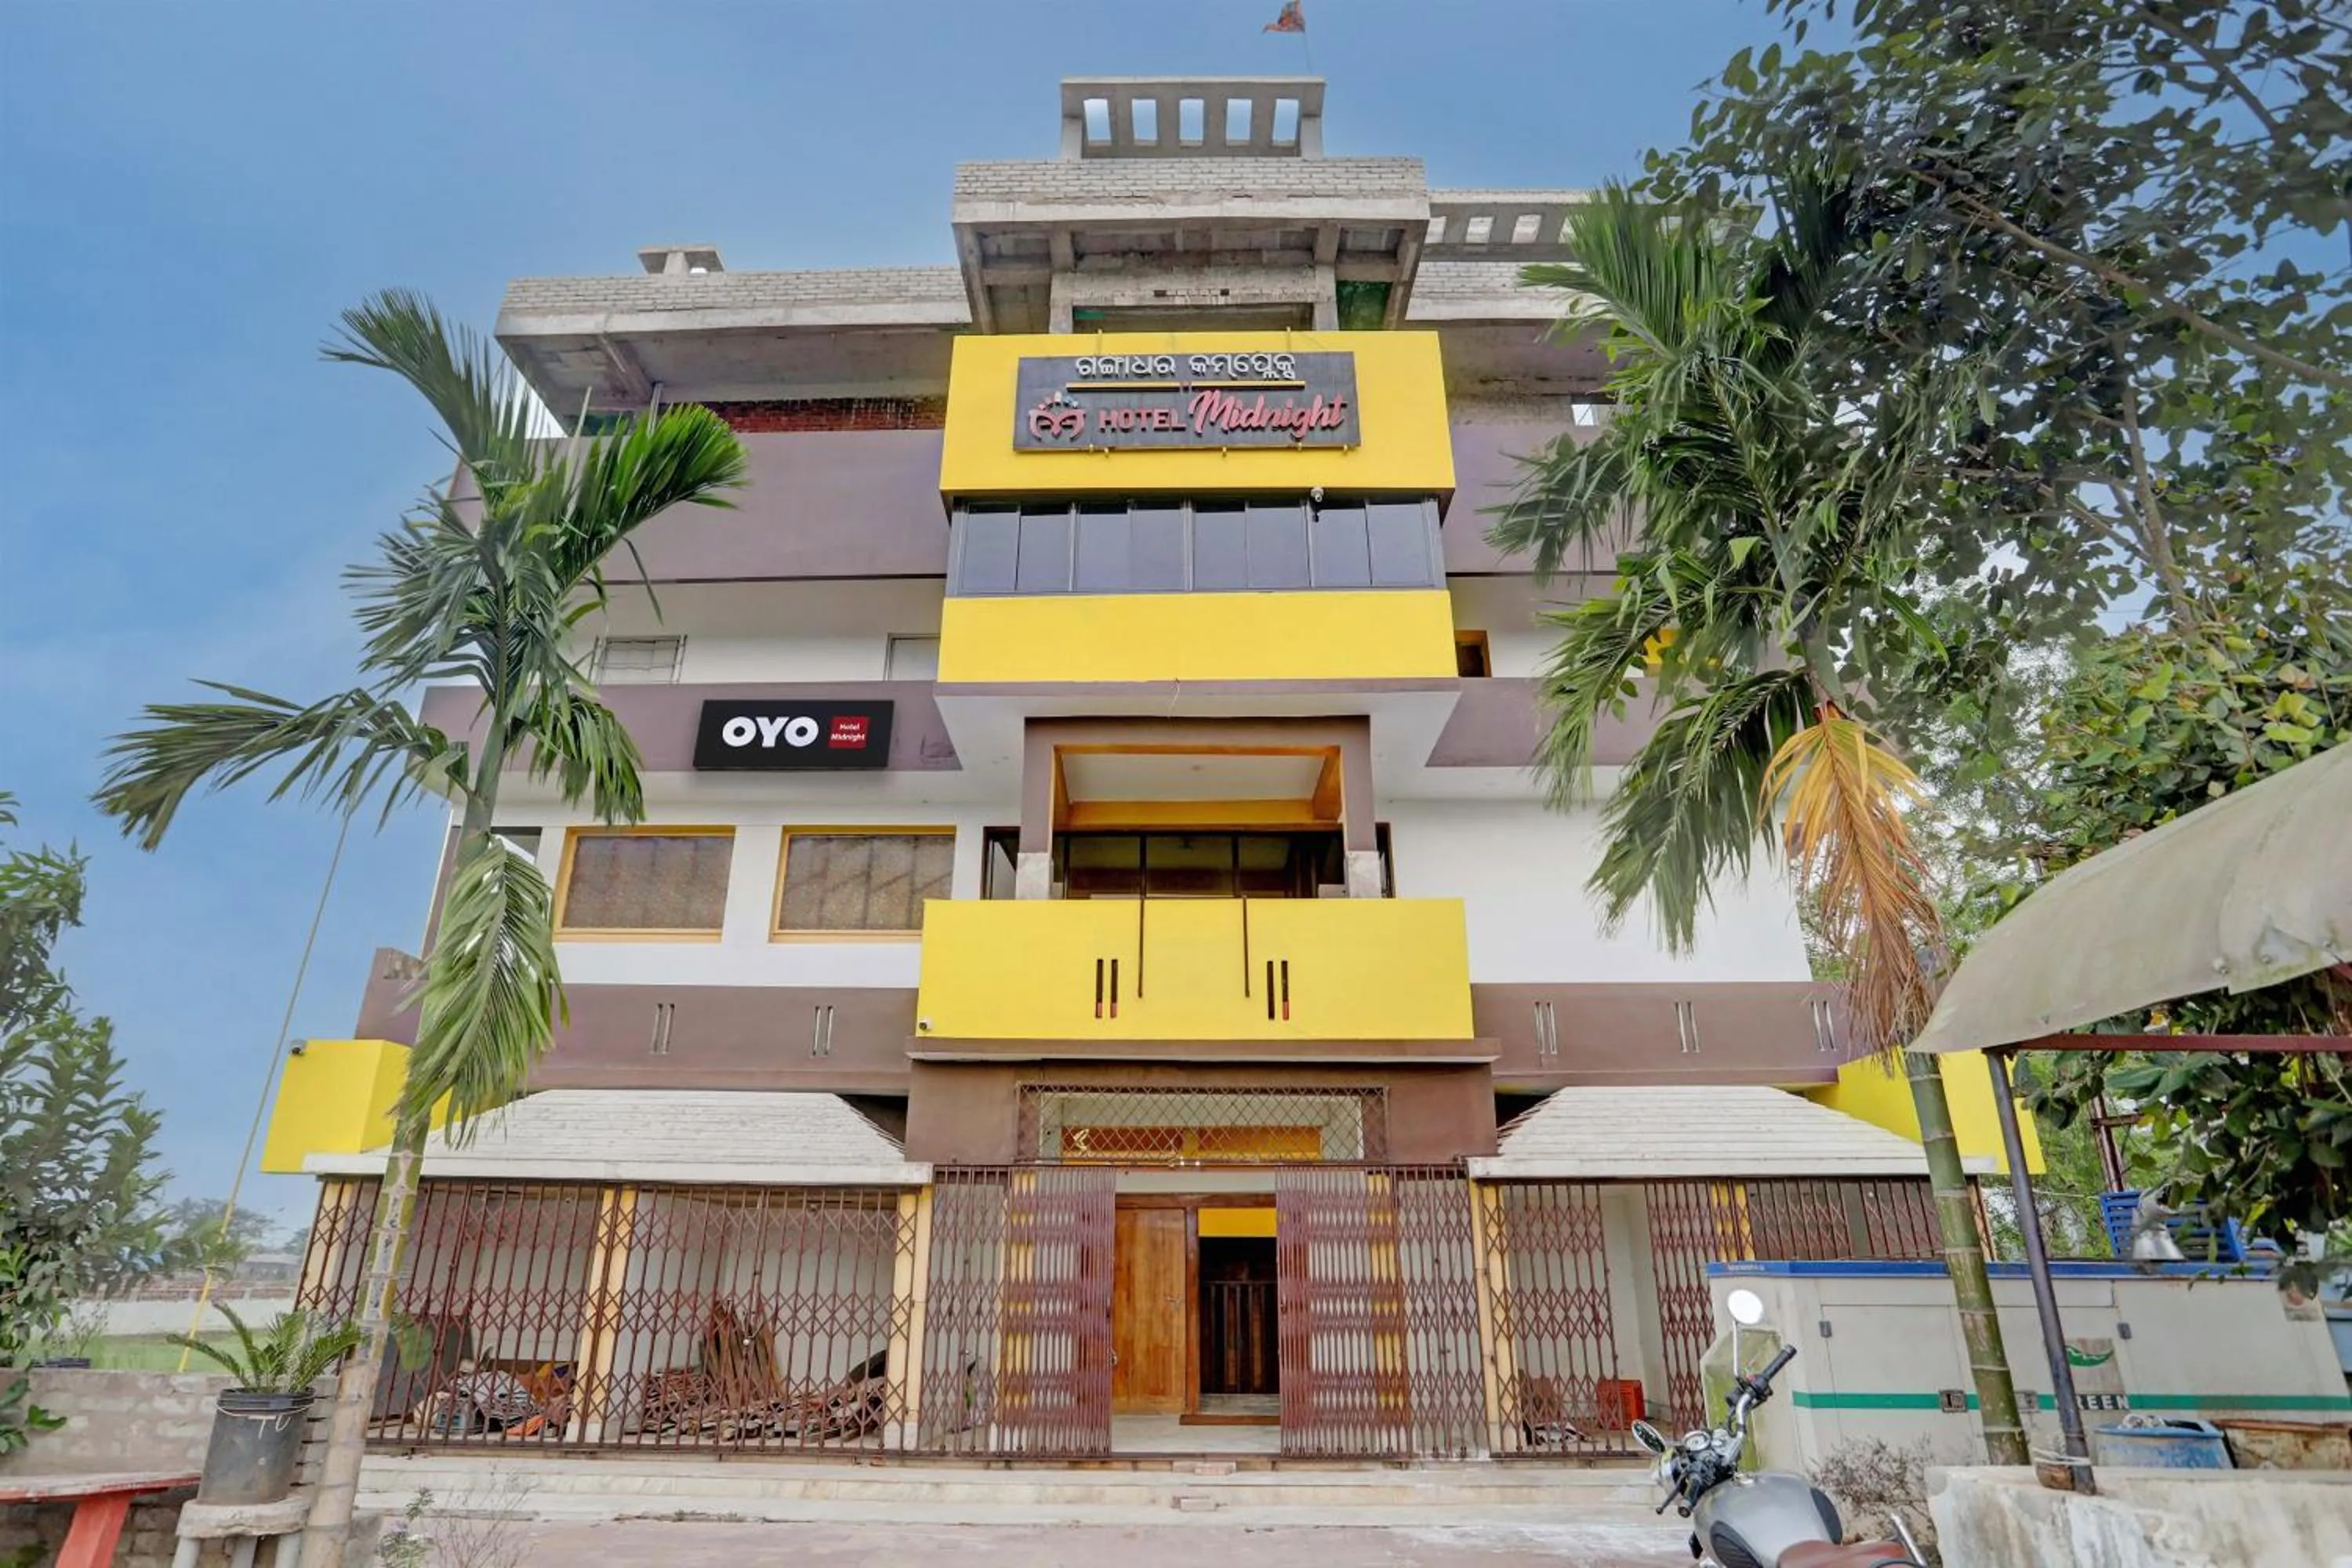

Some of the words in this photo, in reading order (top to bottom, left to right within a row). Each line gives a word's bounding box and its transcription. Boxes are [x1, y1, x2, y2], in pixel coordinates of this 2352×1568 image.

[1076, 356, 1176, 376] ଗଙ୍ଗାଧର
[1100, 408, 1186, 433] HOTEL
[1189, 391, 1347, 438] Midnight
[722, 716, 819, 747] OYO
[831, 733, 866, 742] Midnight
